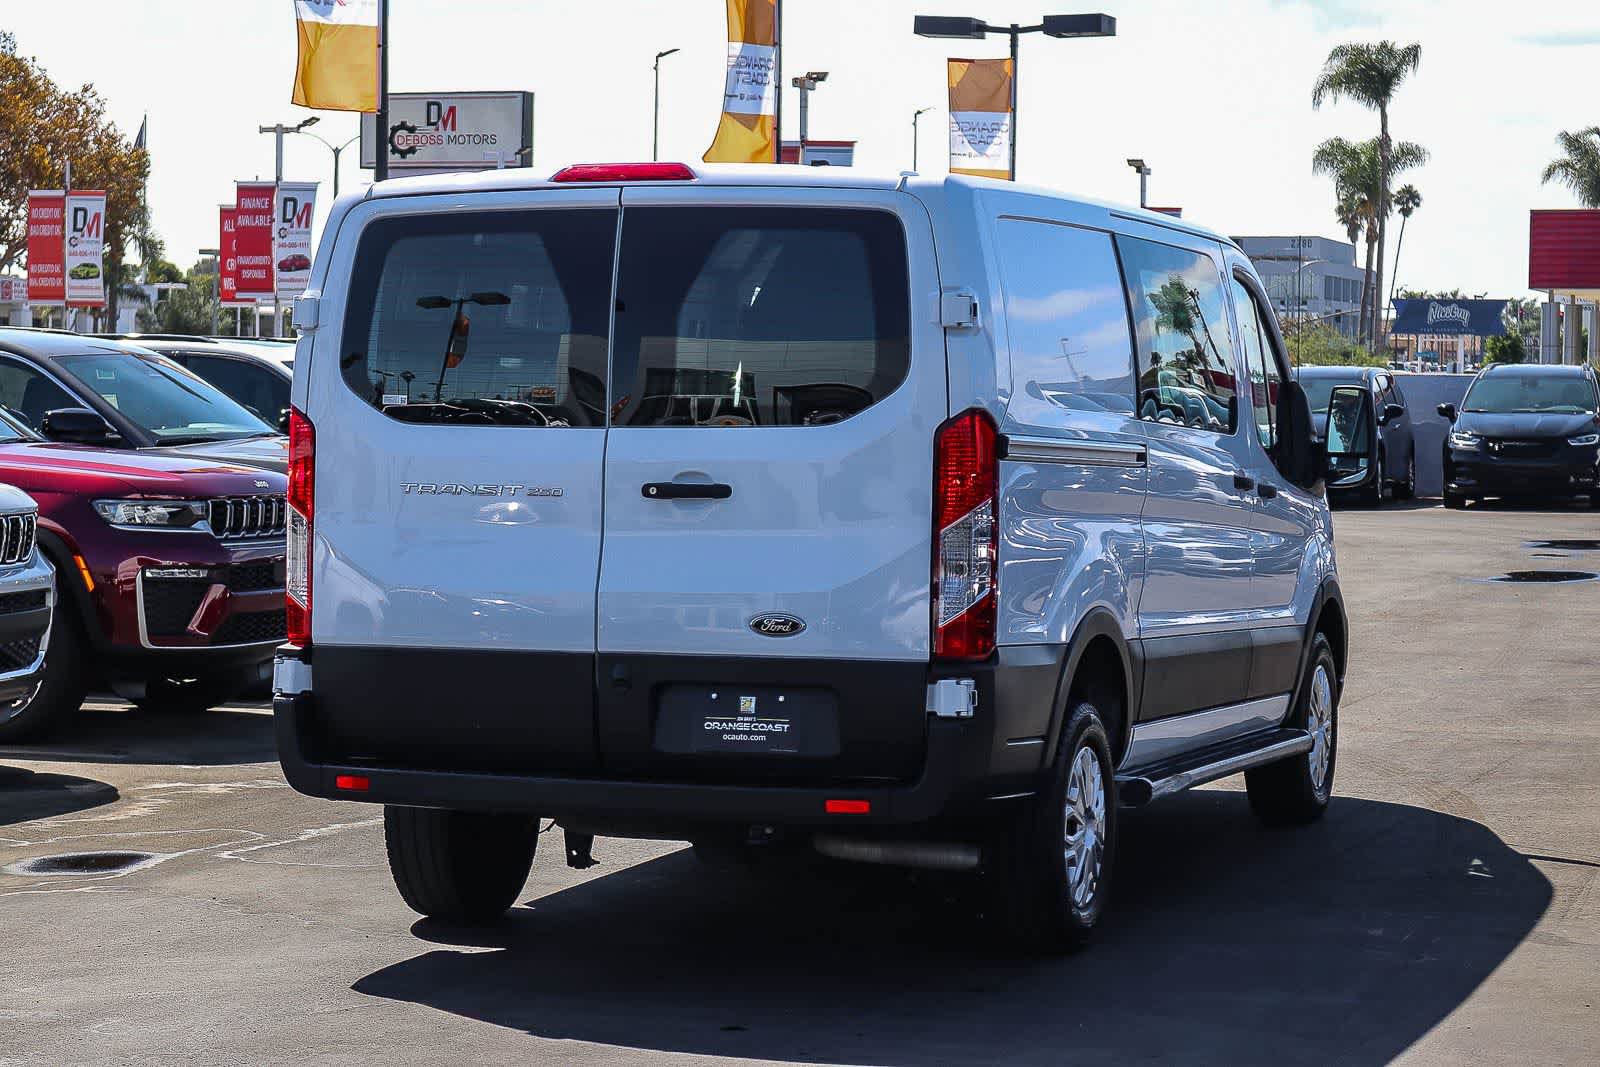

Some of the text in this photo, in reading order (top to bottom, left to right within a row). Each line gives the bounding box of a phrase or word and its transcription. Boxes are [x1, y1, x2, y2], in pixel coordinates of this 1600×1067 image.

[426, 101, 457, 131] DM
[396, 133, 498, 145] DEBOSS MOTORS
[241, 198, 270, 209] FINANCE
[282, 196, 313, 229] DM
[72, 206, 102, 238] DM
[237, 214, 272, 227] AVAILABLE
[400, 483, 564, 497] TRANSIT 250
[760, 617, 793, 633] Ford
[722, 733, 767, 742] ocauto.com
